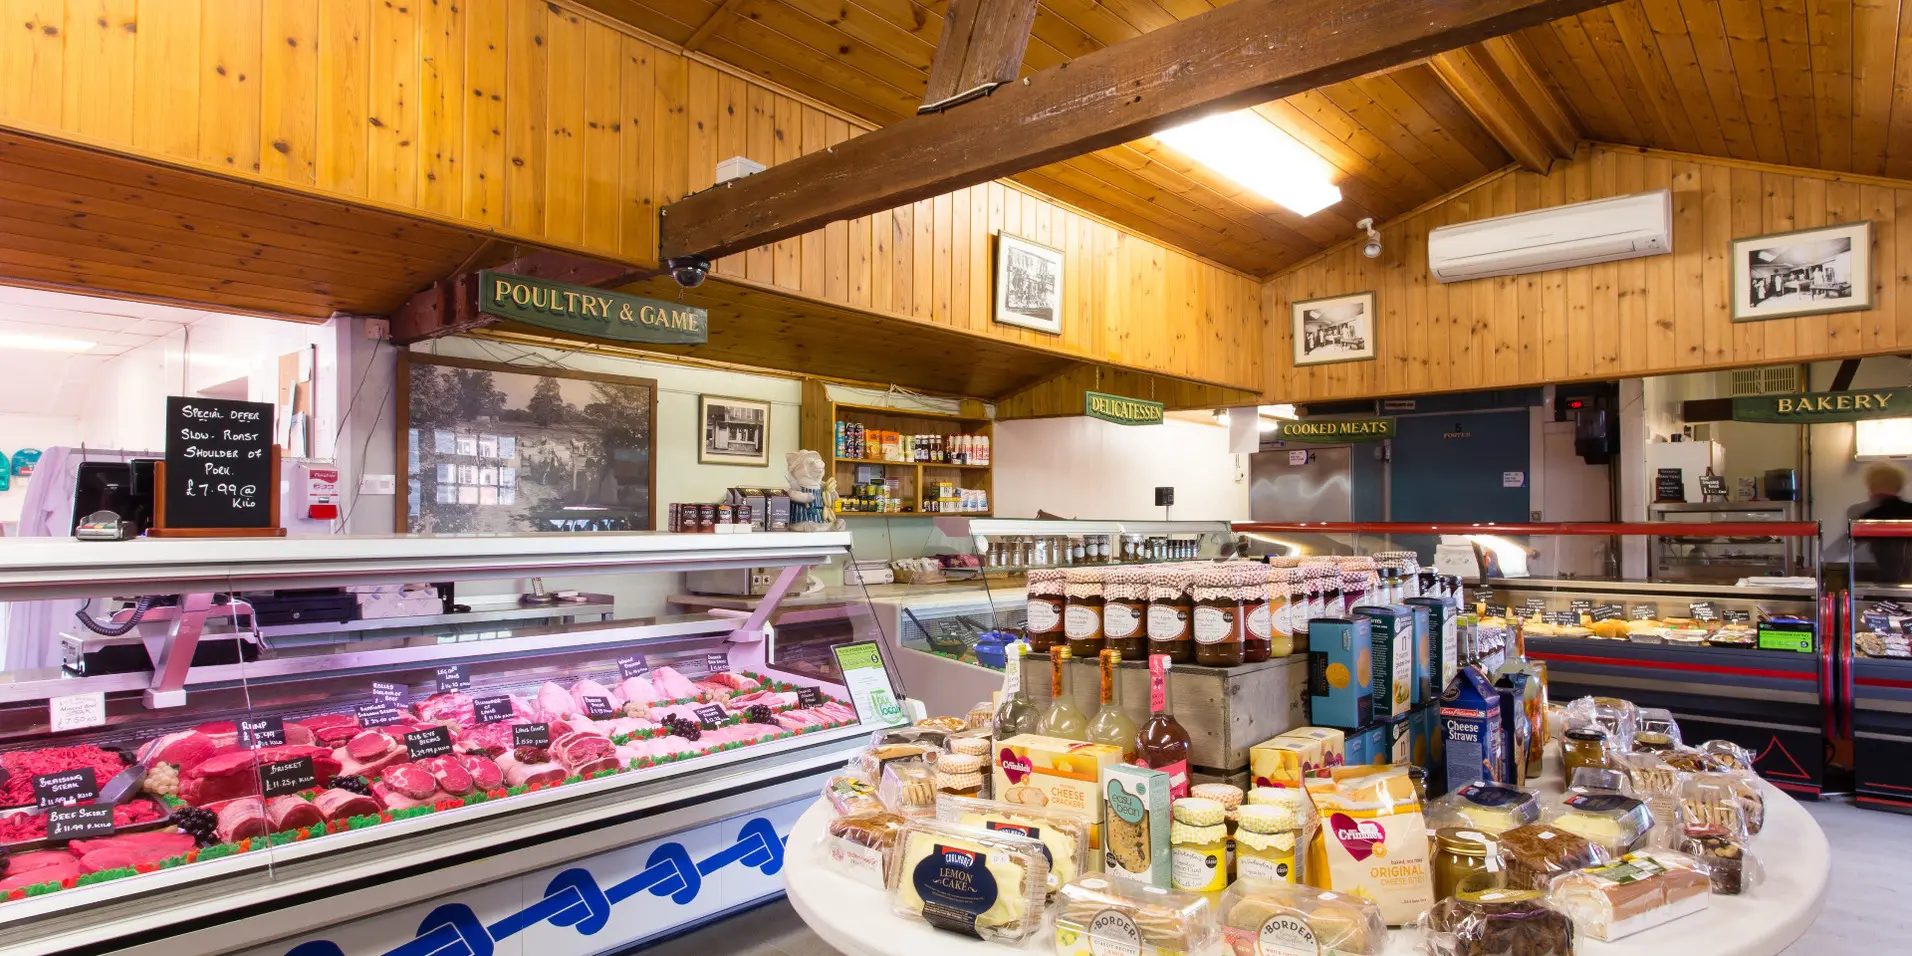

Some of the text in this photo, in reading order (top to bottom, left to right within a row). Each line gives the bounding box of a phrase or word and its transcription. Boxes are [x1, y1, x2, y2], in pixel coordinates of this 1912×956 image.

[495, 279, 700, 332] POULTRY & GAME
[1091, 397, 1161, 420] DELICATESSEN
[1777, 392, 1893, 413] BAKERY
[1283, 421, 1388, 435] COOKED MEATS
[1309, 452, 1316, 463] 4
[242, 721, 267, 731] RUMP
[1447, 719, 1479, 733] Cheese
[1449, 729, 1478, 743] Straws
[1051, 787, 1084, 802] CHEESE
[1112, 794, 1132, 807] easy
[50, 811, 77, 821] BEEF
[1116, 802, 1140, 817] bean
[945, 853, 971, 867] COOLMORE
[940, 867, 974, 883] LEMON
[1370, 864, 1425, 878] ORIGINAL
[942, 877, 967, 891] CAKE
[1095, 916, 1136, 938] BORDER
[1265, 920, 1312, 942] BORDER
